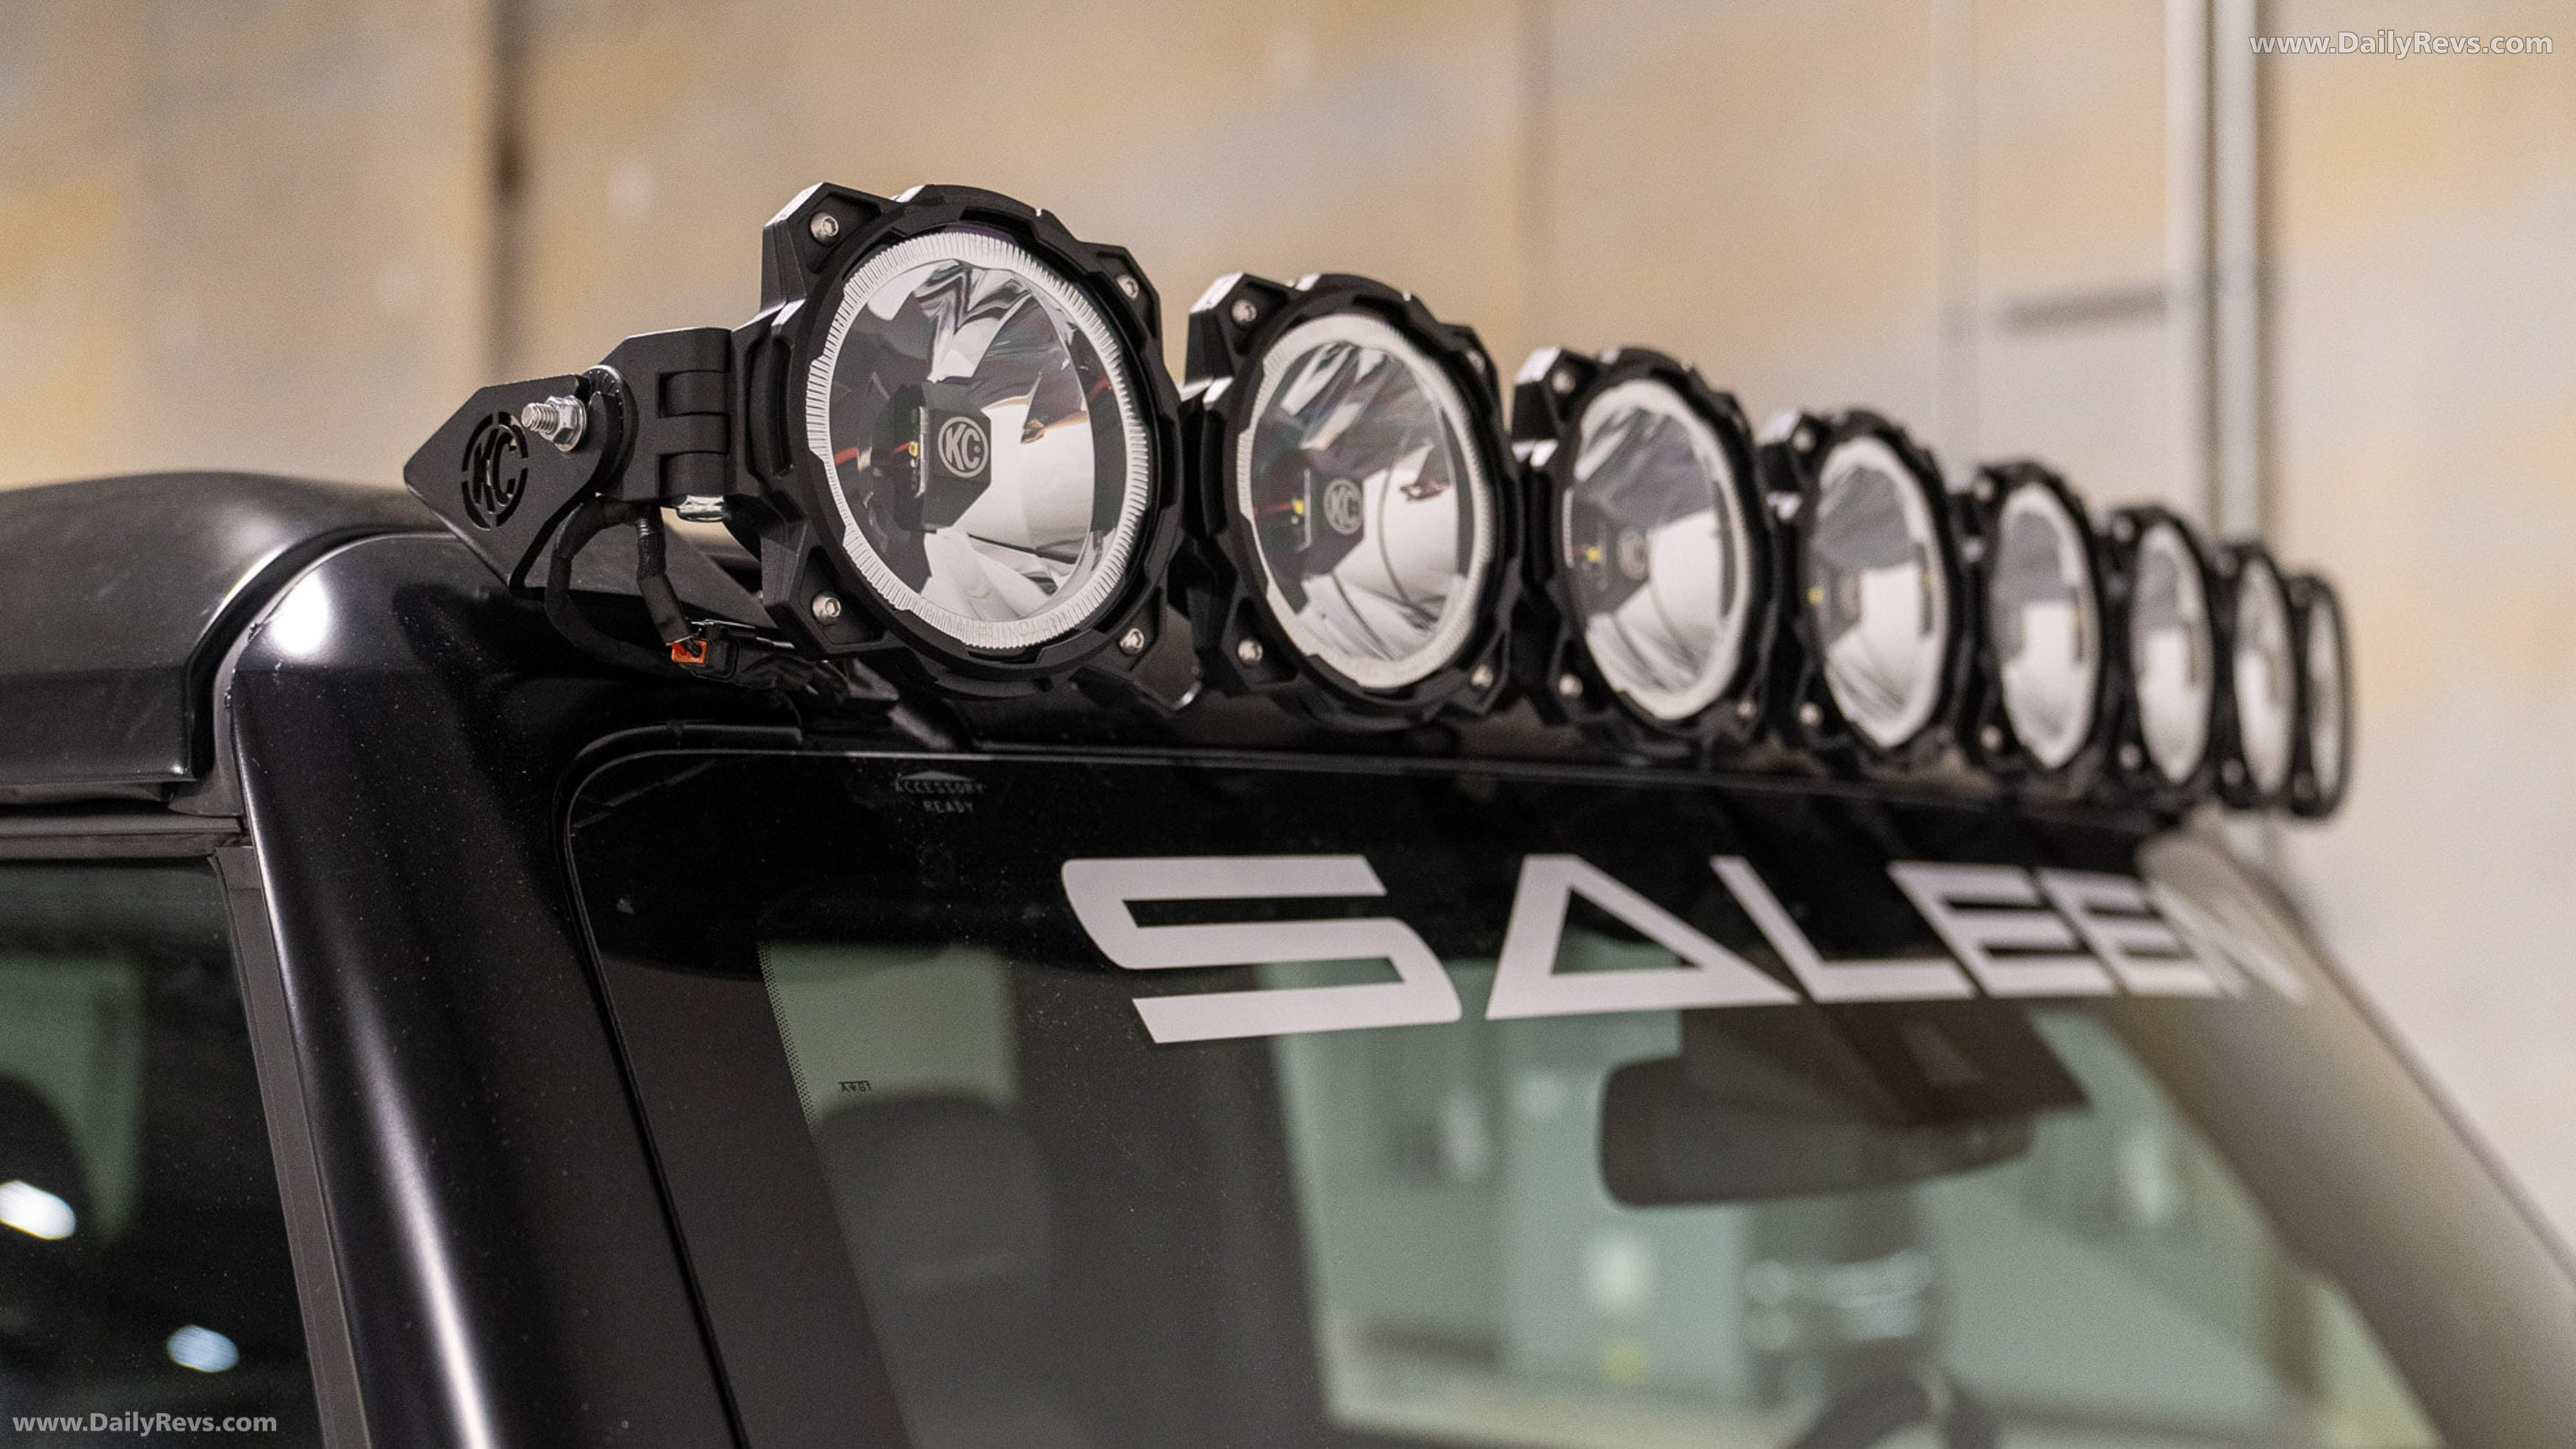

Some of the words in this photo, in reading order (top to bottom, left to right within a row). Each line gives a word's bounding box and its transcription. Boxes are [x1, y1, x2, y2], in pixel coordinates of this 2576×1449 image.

[473, 427, 518, 512] KC
[895, 780, 985, 794] ACCESSORY
[923, 800, 974, 813] READY
